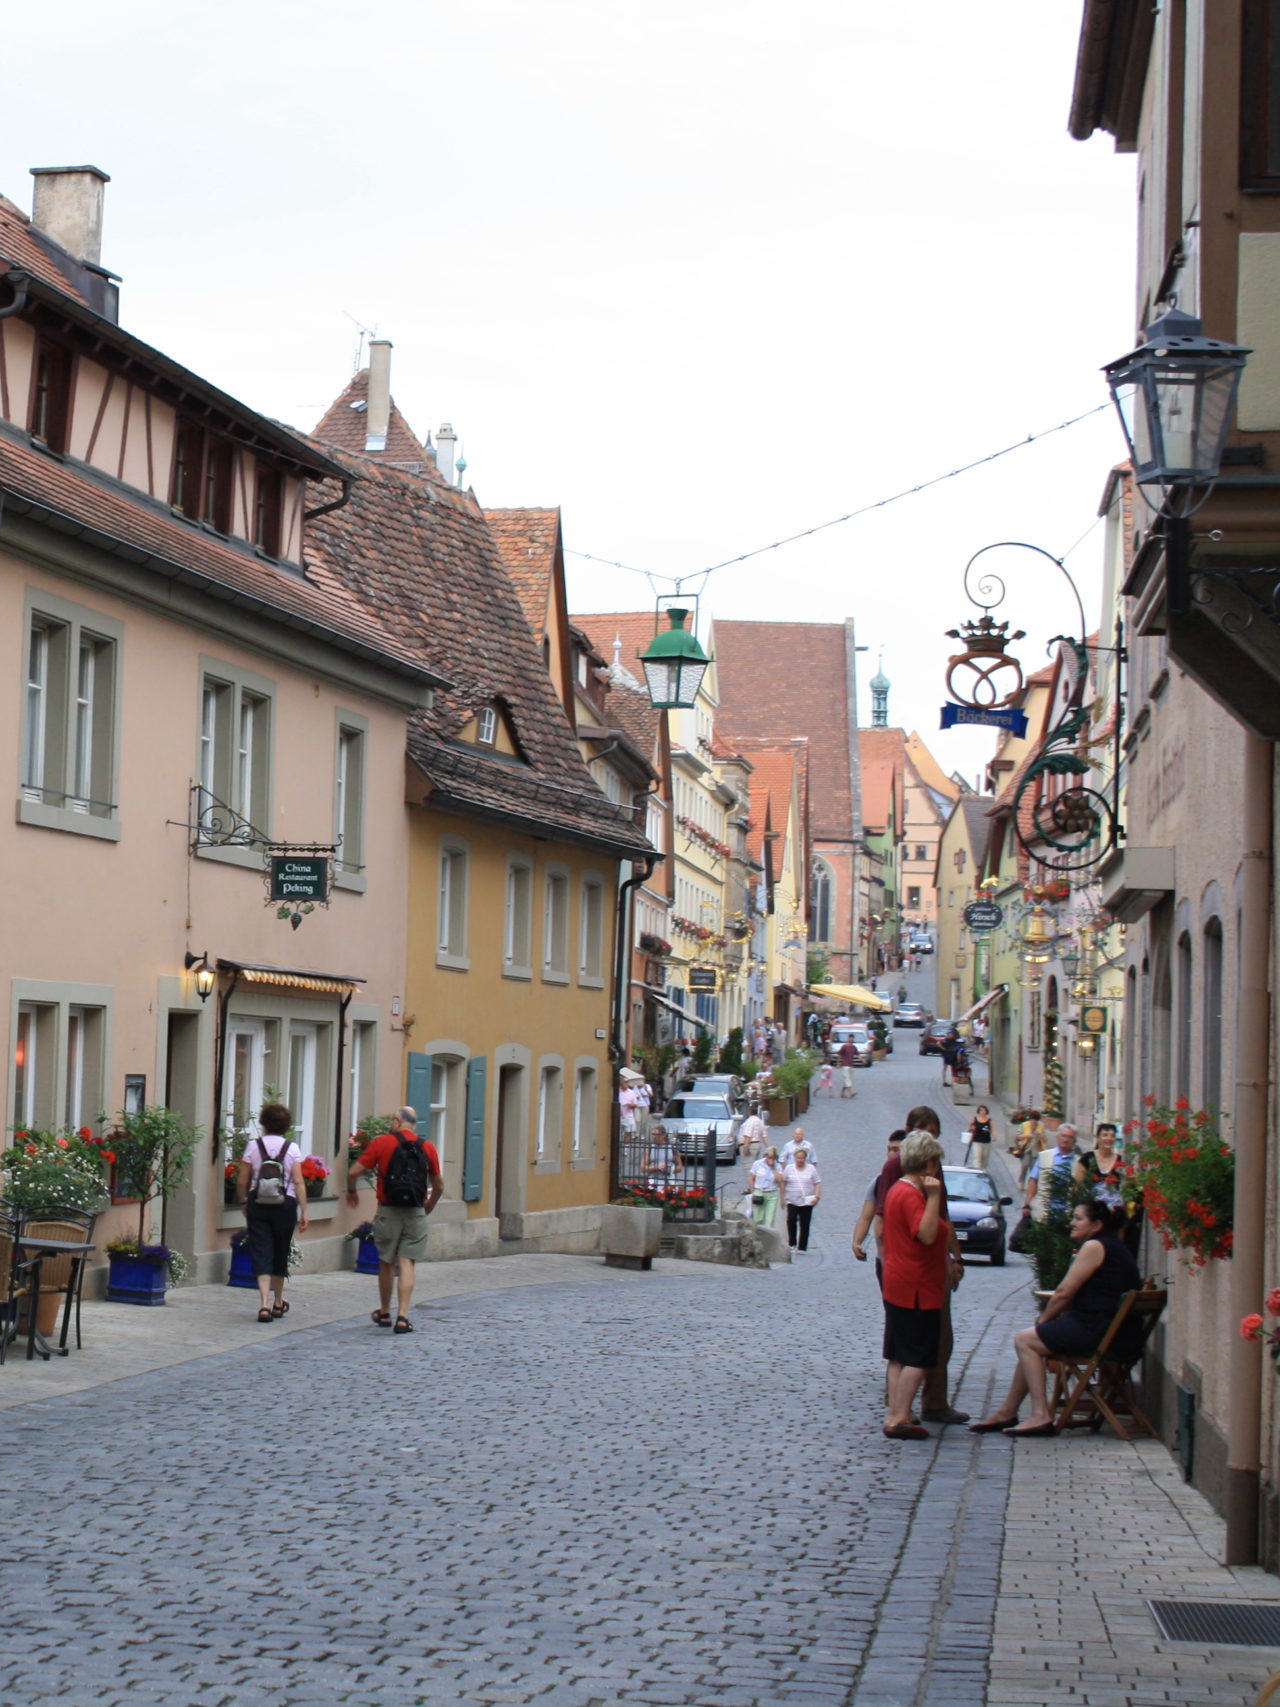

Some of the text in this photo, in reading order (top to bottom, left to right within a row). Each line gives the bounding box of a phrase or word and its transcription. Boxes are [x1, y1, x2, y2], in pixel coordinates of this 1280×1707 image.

[956, 708, 1014, 726] Bäckerei
[285, 863, 312, 873] China
[278, 873, 318, 881] Restaurant
[282, 882, 314, 895] Peking
